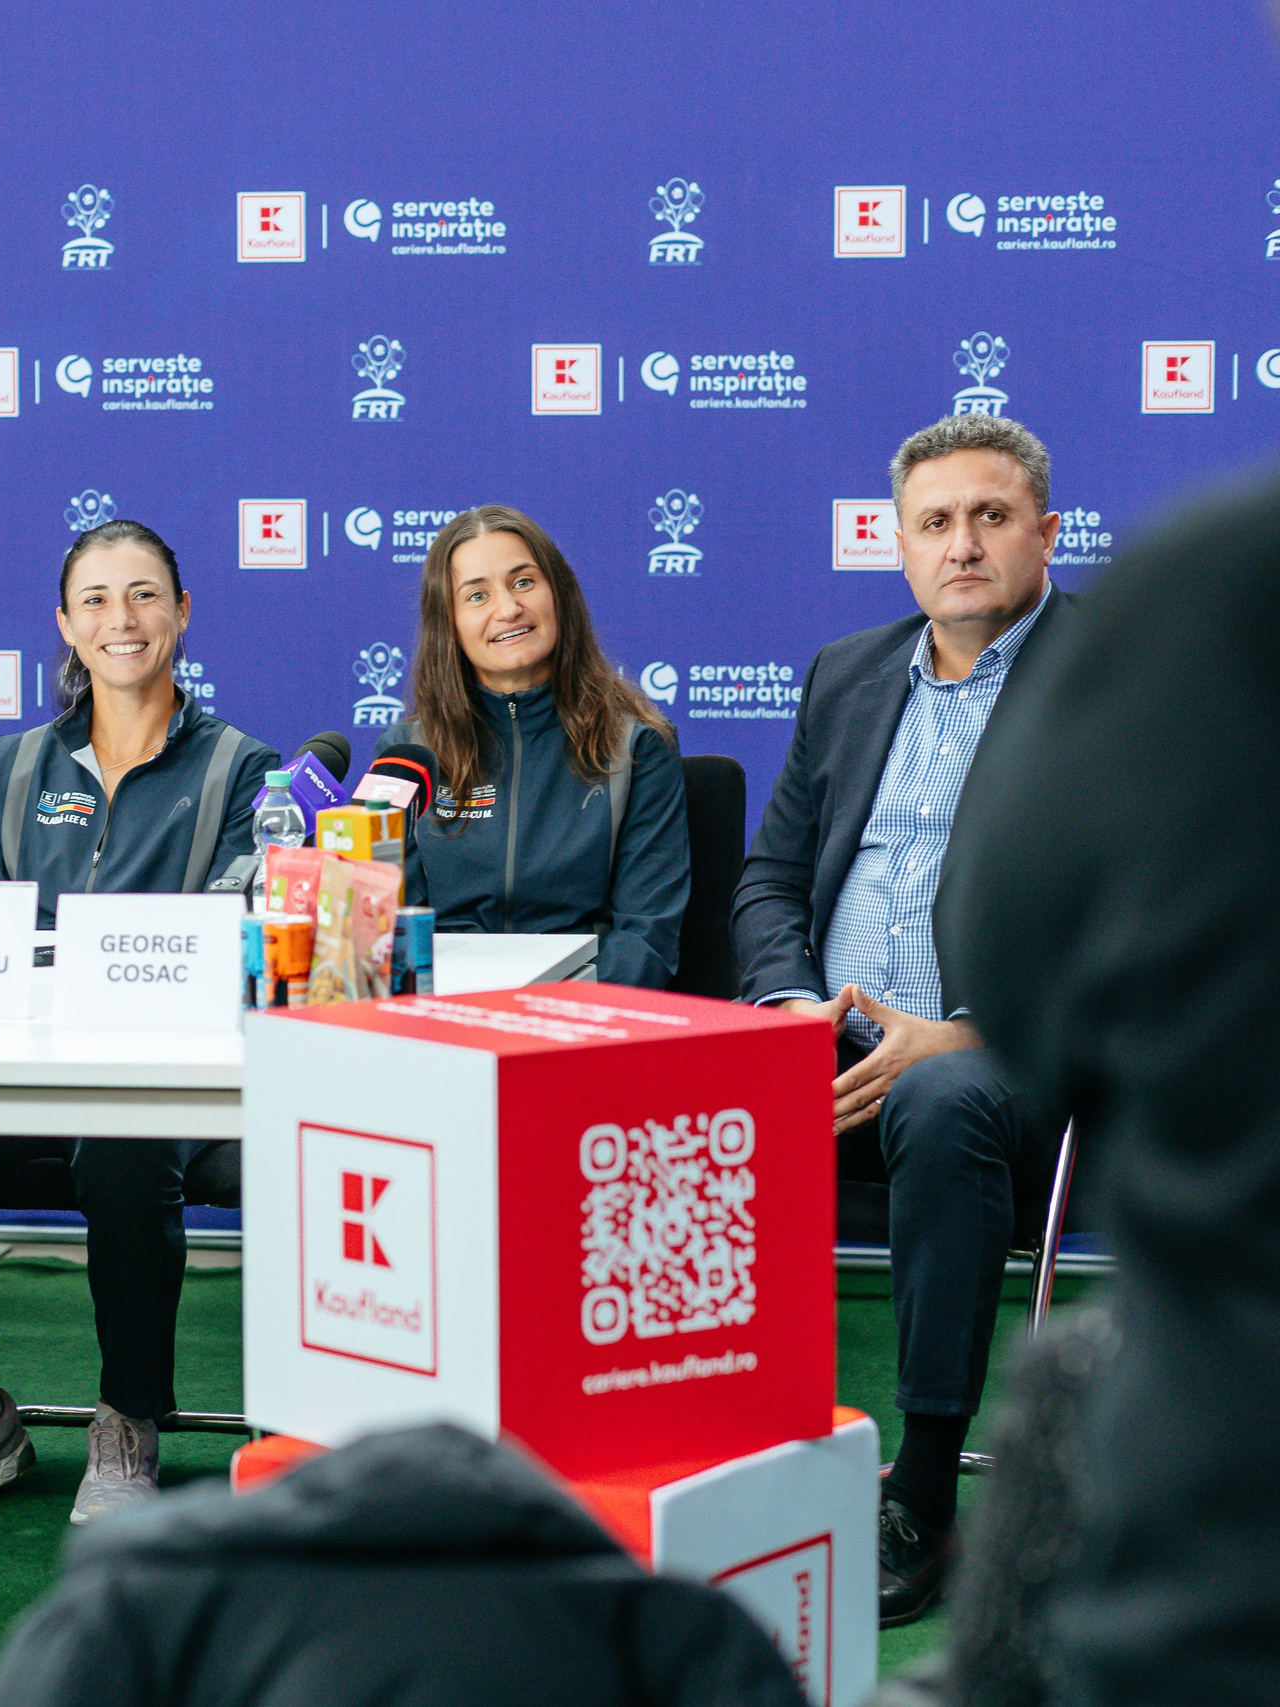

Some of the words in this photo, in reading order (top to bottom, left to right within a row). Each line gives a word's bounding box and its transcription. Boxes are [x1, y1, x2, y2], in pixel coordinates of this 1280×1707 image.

[392, 197, 494, 221] servește
[858, 201, 881, 227] K
[997, 191, 1104, 216] servește
[260, 206, 282, 232] K
[392, 217, 506, 242] inspirație
[997, 212, 1116, 236] inspirație
[392, 241, 506, 255] cariere.kaufland.ro
[845, 233, 894, 243] Kaufland
[997, 235, 1116, 250] cariere.kaufland.ro
[62, 248, 115, 267] FRT
[649, 242, 704, 262] FRT
[554, 359, 578, 385] K
[690, 351, 795, 375] servește
[1165, 356, 1191, 382] K
[690, 371, 807, 395] inspirație
[103, 396, 213, 410] cariere.kaufland.ro
[690, 394, 807, 408] cariere.kaufland.ro
[1153, 389, 1203, 399] Kaufland
[352, 399, 405, 418] FRT
[953, 398, 1008, 417] FRT
[261, 514, 284, 539] K
[393, 509, 468, 526] serve
[855, 514, 880, 540] K
[843, 545, 893, 556] Kaufland
[648, 554, 702, 573] FRT
[353, 707, 404, 725] FRT
[689, 706, 797, 719] cariere.kaufland.r
[100, 934, 199, 955] GEORGE
[106, 963, 189, 984] COSAC
[341, 1171, 393, 1269] K
[314, 1279, 423, 1336] Kaufland
[582, 1349, 759, 1396] cariere.kaufland.ro
